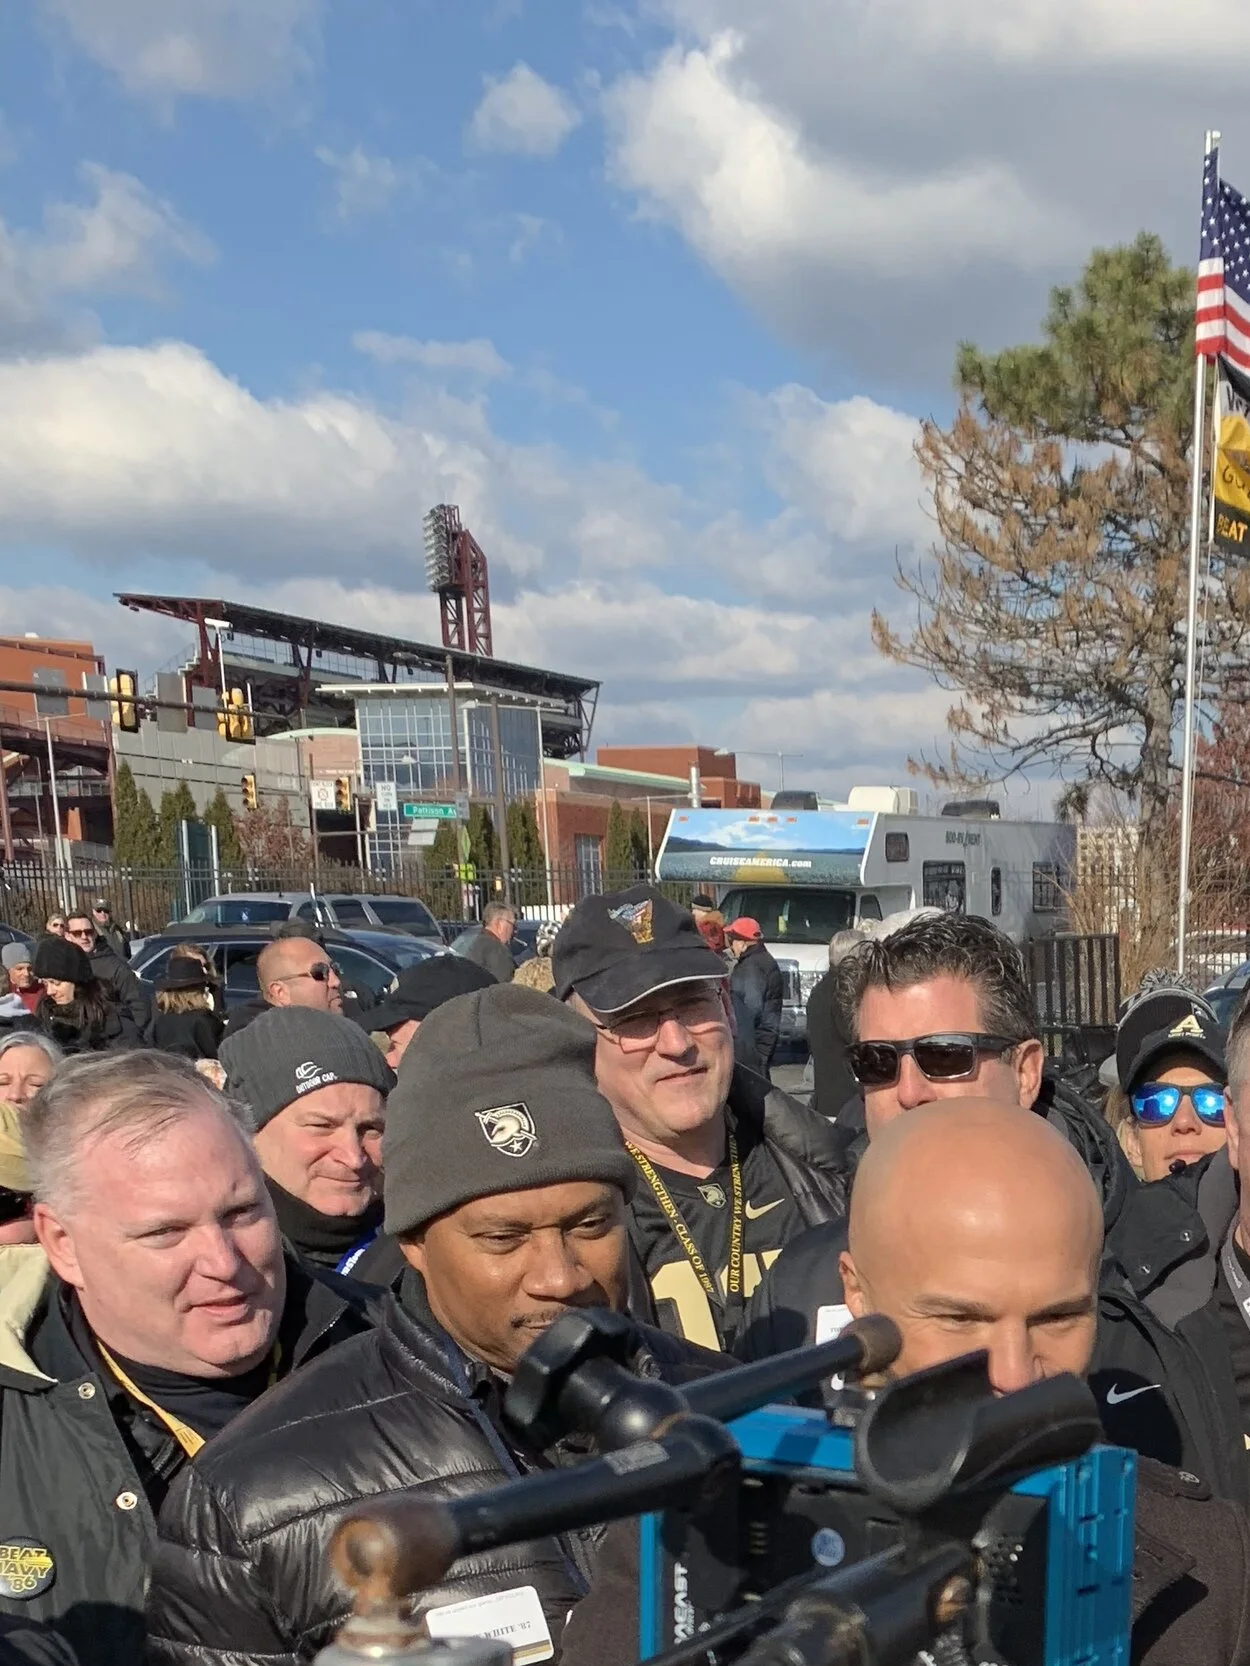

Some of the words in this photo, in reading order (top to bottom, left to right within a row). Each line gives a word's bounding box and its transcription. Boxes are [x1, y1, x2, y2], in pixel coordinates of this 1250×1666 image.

[412, 805, 445, 816] Pattison
[675, 1223, 698, 1258] CLASS
[730, 1217, 743, 1269] COUNTRY
[729, 1269, 742, 1293] OUR
[484, 1625, 516, 1640] WHITE
